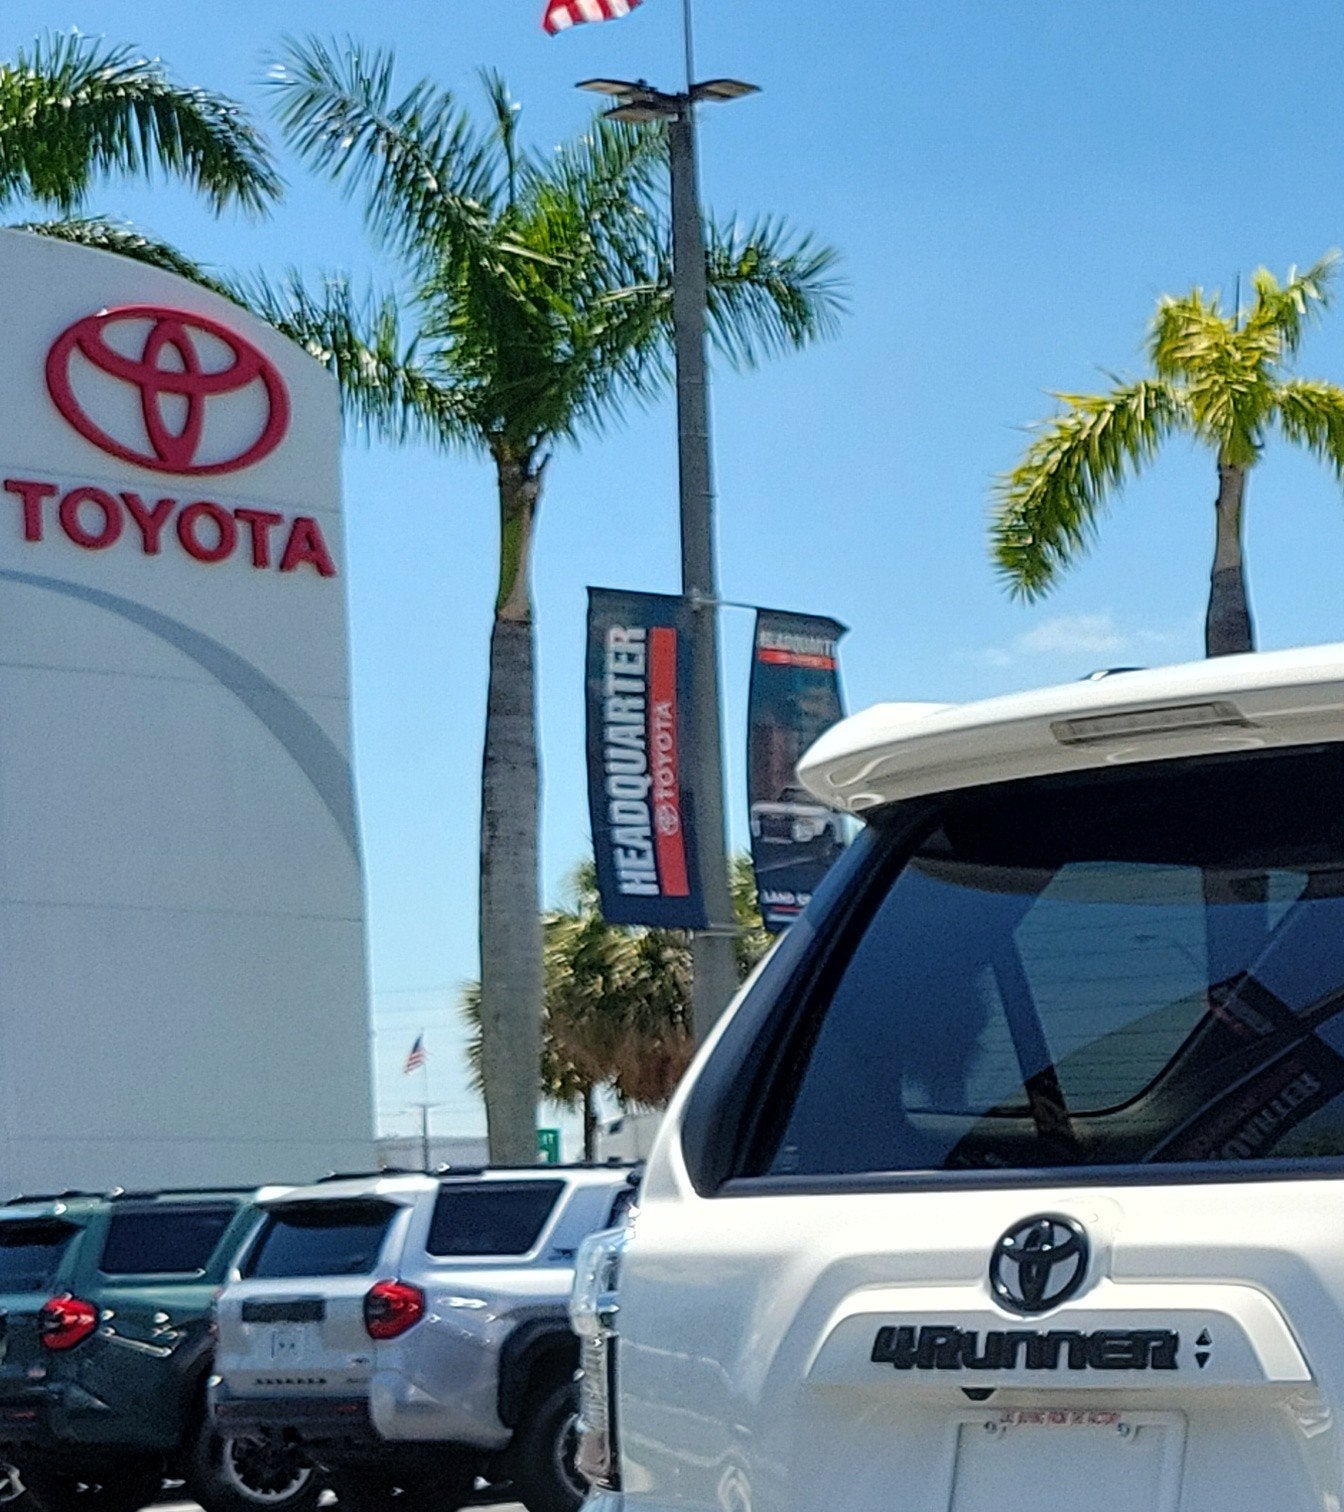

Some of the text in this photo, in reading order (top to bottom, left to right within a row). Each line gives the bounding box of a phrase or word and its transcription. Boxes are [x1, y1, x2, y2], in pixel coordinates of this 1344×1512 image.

[3, 478, 337, 578] TOYOTA
[605, 624, 660, 896] HEADQUARTER
[655, 701, 676, 800] TOYOTA
[871, 1325, 1180, 1370] 4RUNNER
